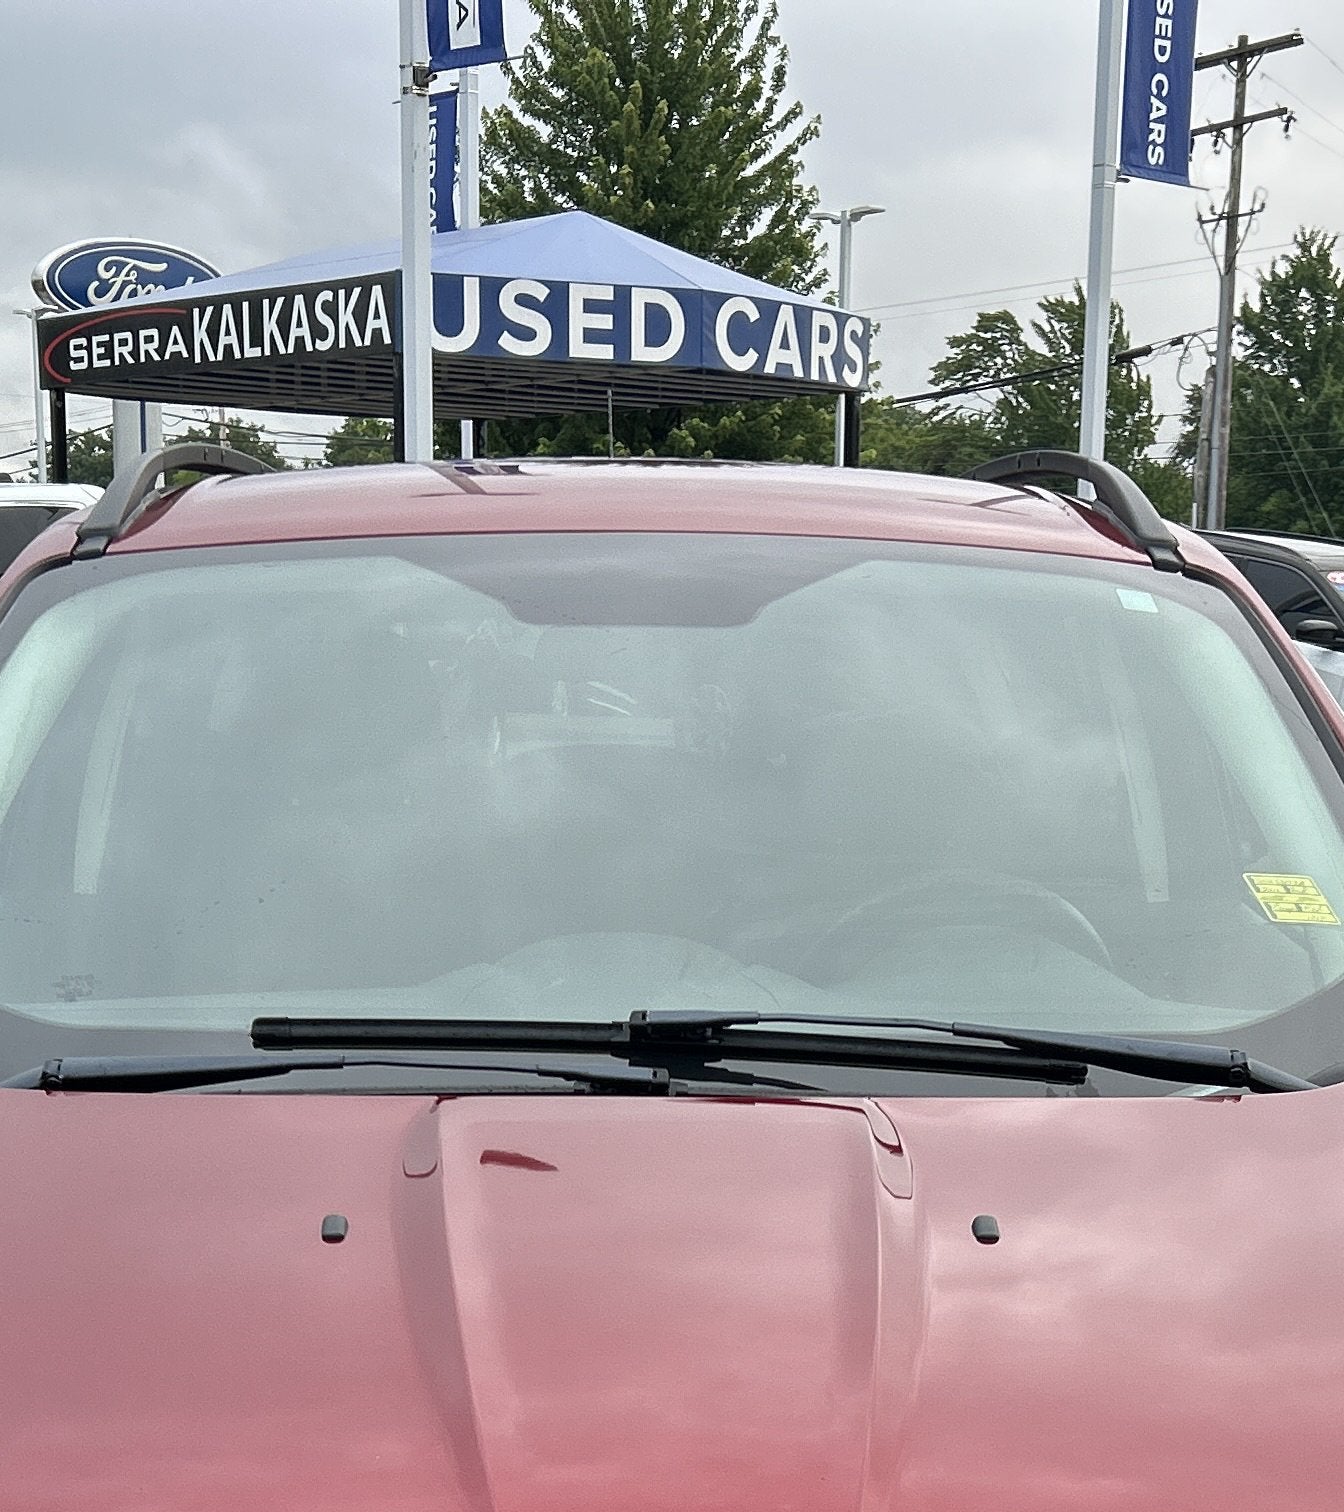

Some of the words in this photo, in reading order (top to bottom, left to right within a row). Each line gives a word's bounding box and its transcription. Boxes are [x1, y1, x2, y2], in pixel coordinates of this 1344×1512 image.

[1154, 0, 1174, 63] SED
[1147, 73, 1169, 166] CARS
[69, 326, 189, 371] SERRA
[192, 284, 392, 364] KALKASKA
[431, 276, 686, 363] USED
[715, 297, 865, 388] CARS
